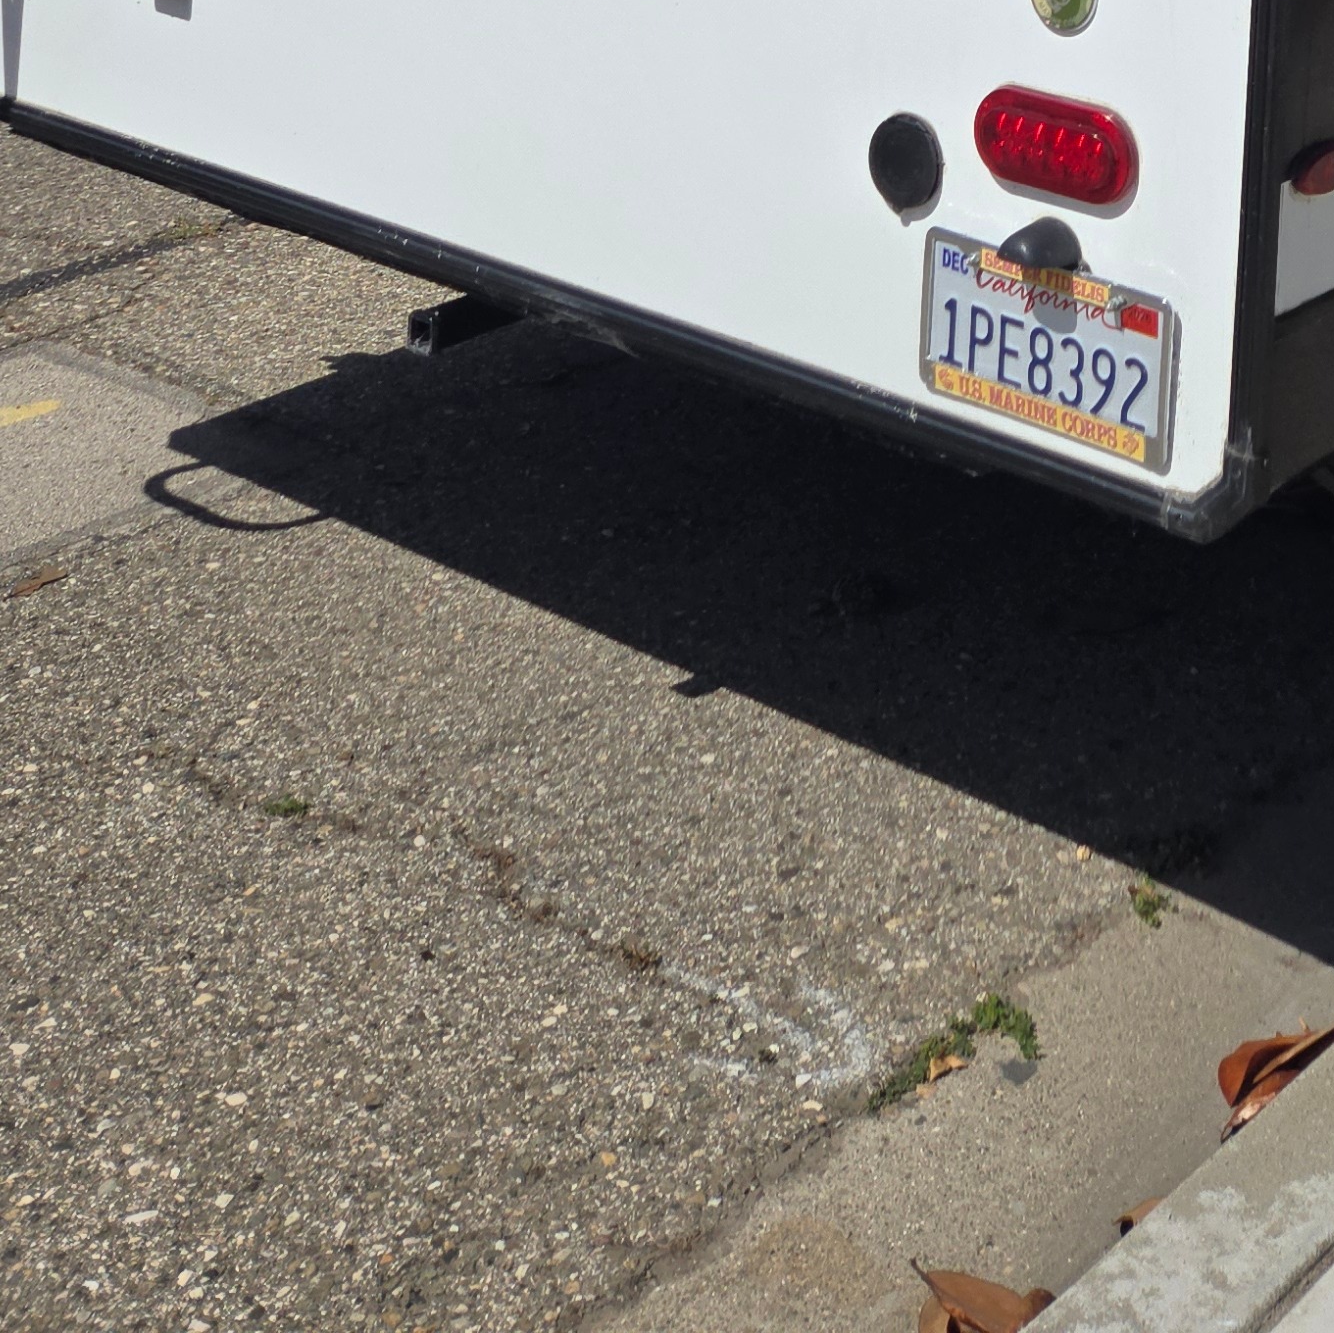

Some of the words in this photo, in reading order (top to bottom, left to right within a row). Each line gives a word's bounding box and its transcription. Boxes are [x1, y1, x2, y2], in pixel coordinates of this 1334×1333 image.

[942, 247, 968, 276] DEC
[1045, 270, 1105, 303] FIDELIS
[976, 268, 1122, 330] California
[938, 297, 1148, 432] 1PE8392
[959, 376, 986, 403] U.S.
[989, 384, 1057, 427] MARINE
[1061, 410, 1118, 449] CORPS
